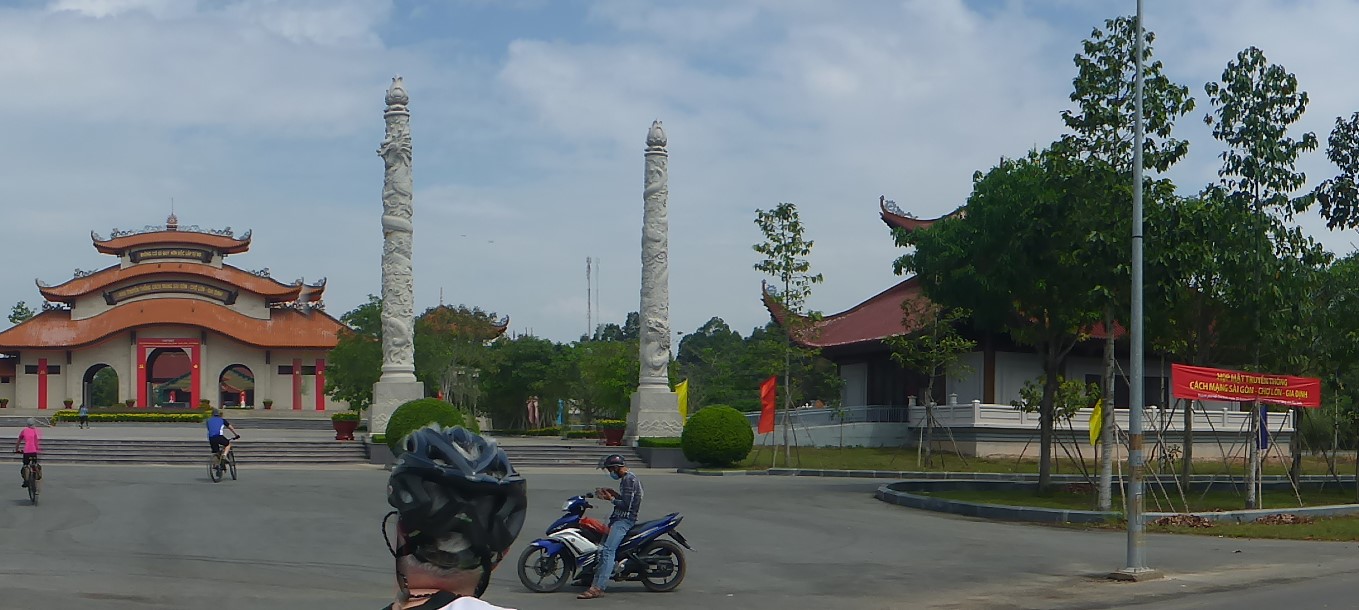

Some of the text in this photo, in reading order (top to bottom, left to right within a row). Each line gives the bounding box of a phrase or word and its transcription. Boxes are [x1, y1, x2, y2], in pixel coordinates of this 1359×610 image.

[1189, 380, 1208, 391] CÁCH
[1228, 383, 1239, 393] SÀI
[1240, 384, 1255, 394] GÒN
